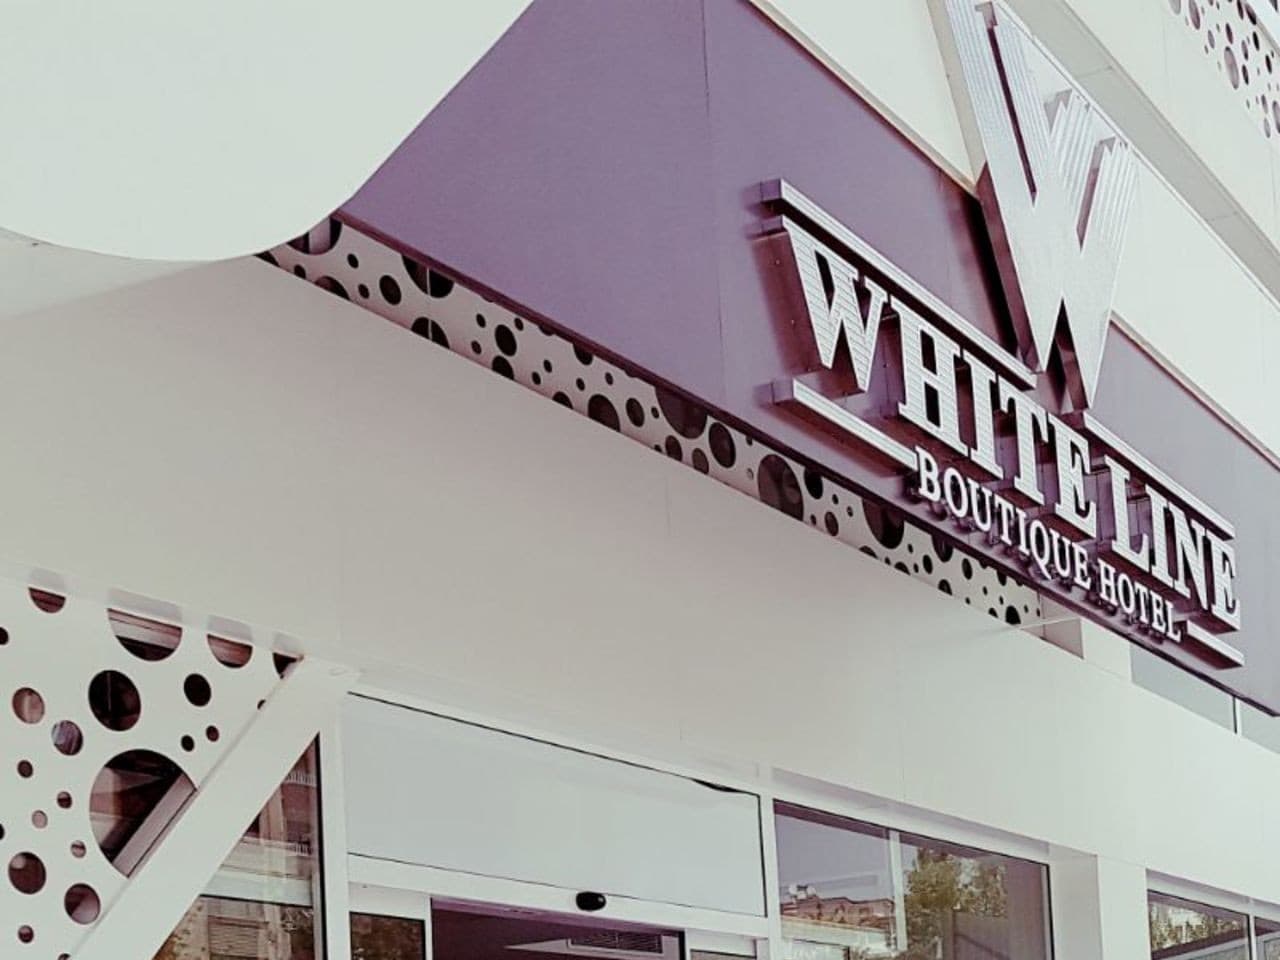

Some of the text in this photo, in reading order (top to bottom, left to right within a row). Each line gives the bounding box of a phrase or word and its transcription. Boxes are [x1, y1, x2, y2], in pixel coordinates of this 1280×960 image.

[782, 215, 1241, 632] WHITE LINE
[914, 445, 1182, 643] BOUTIQUE HOTEL
